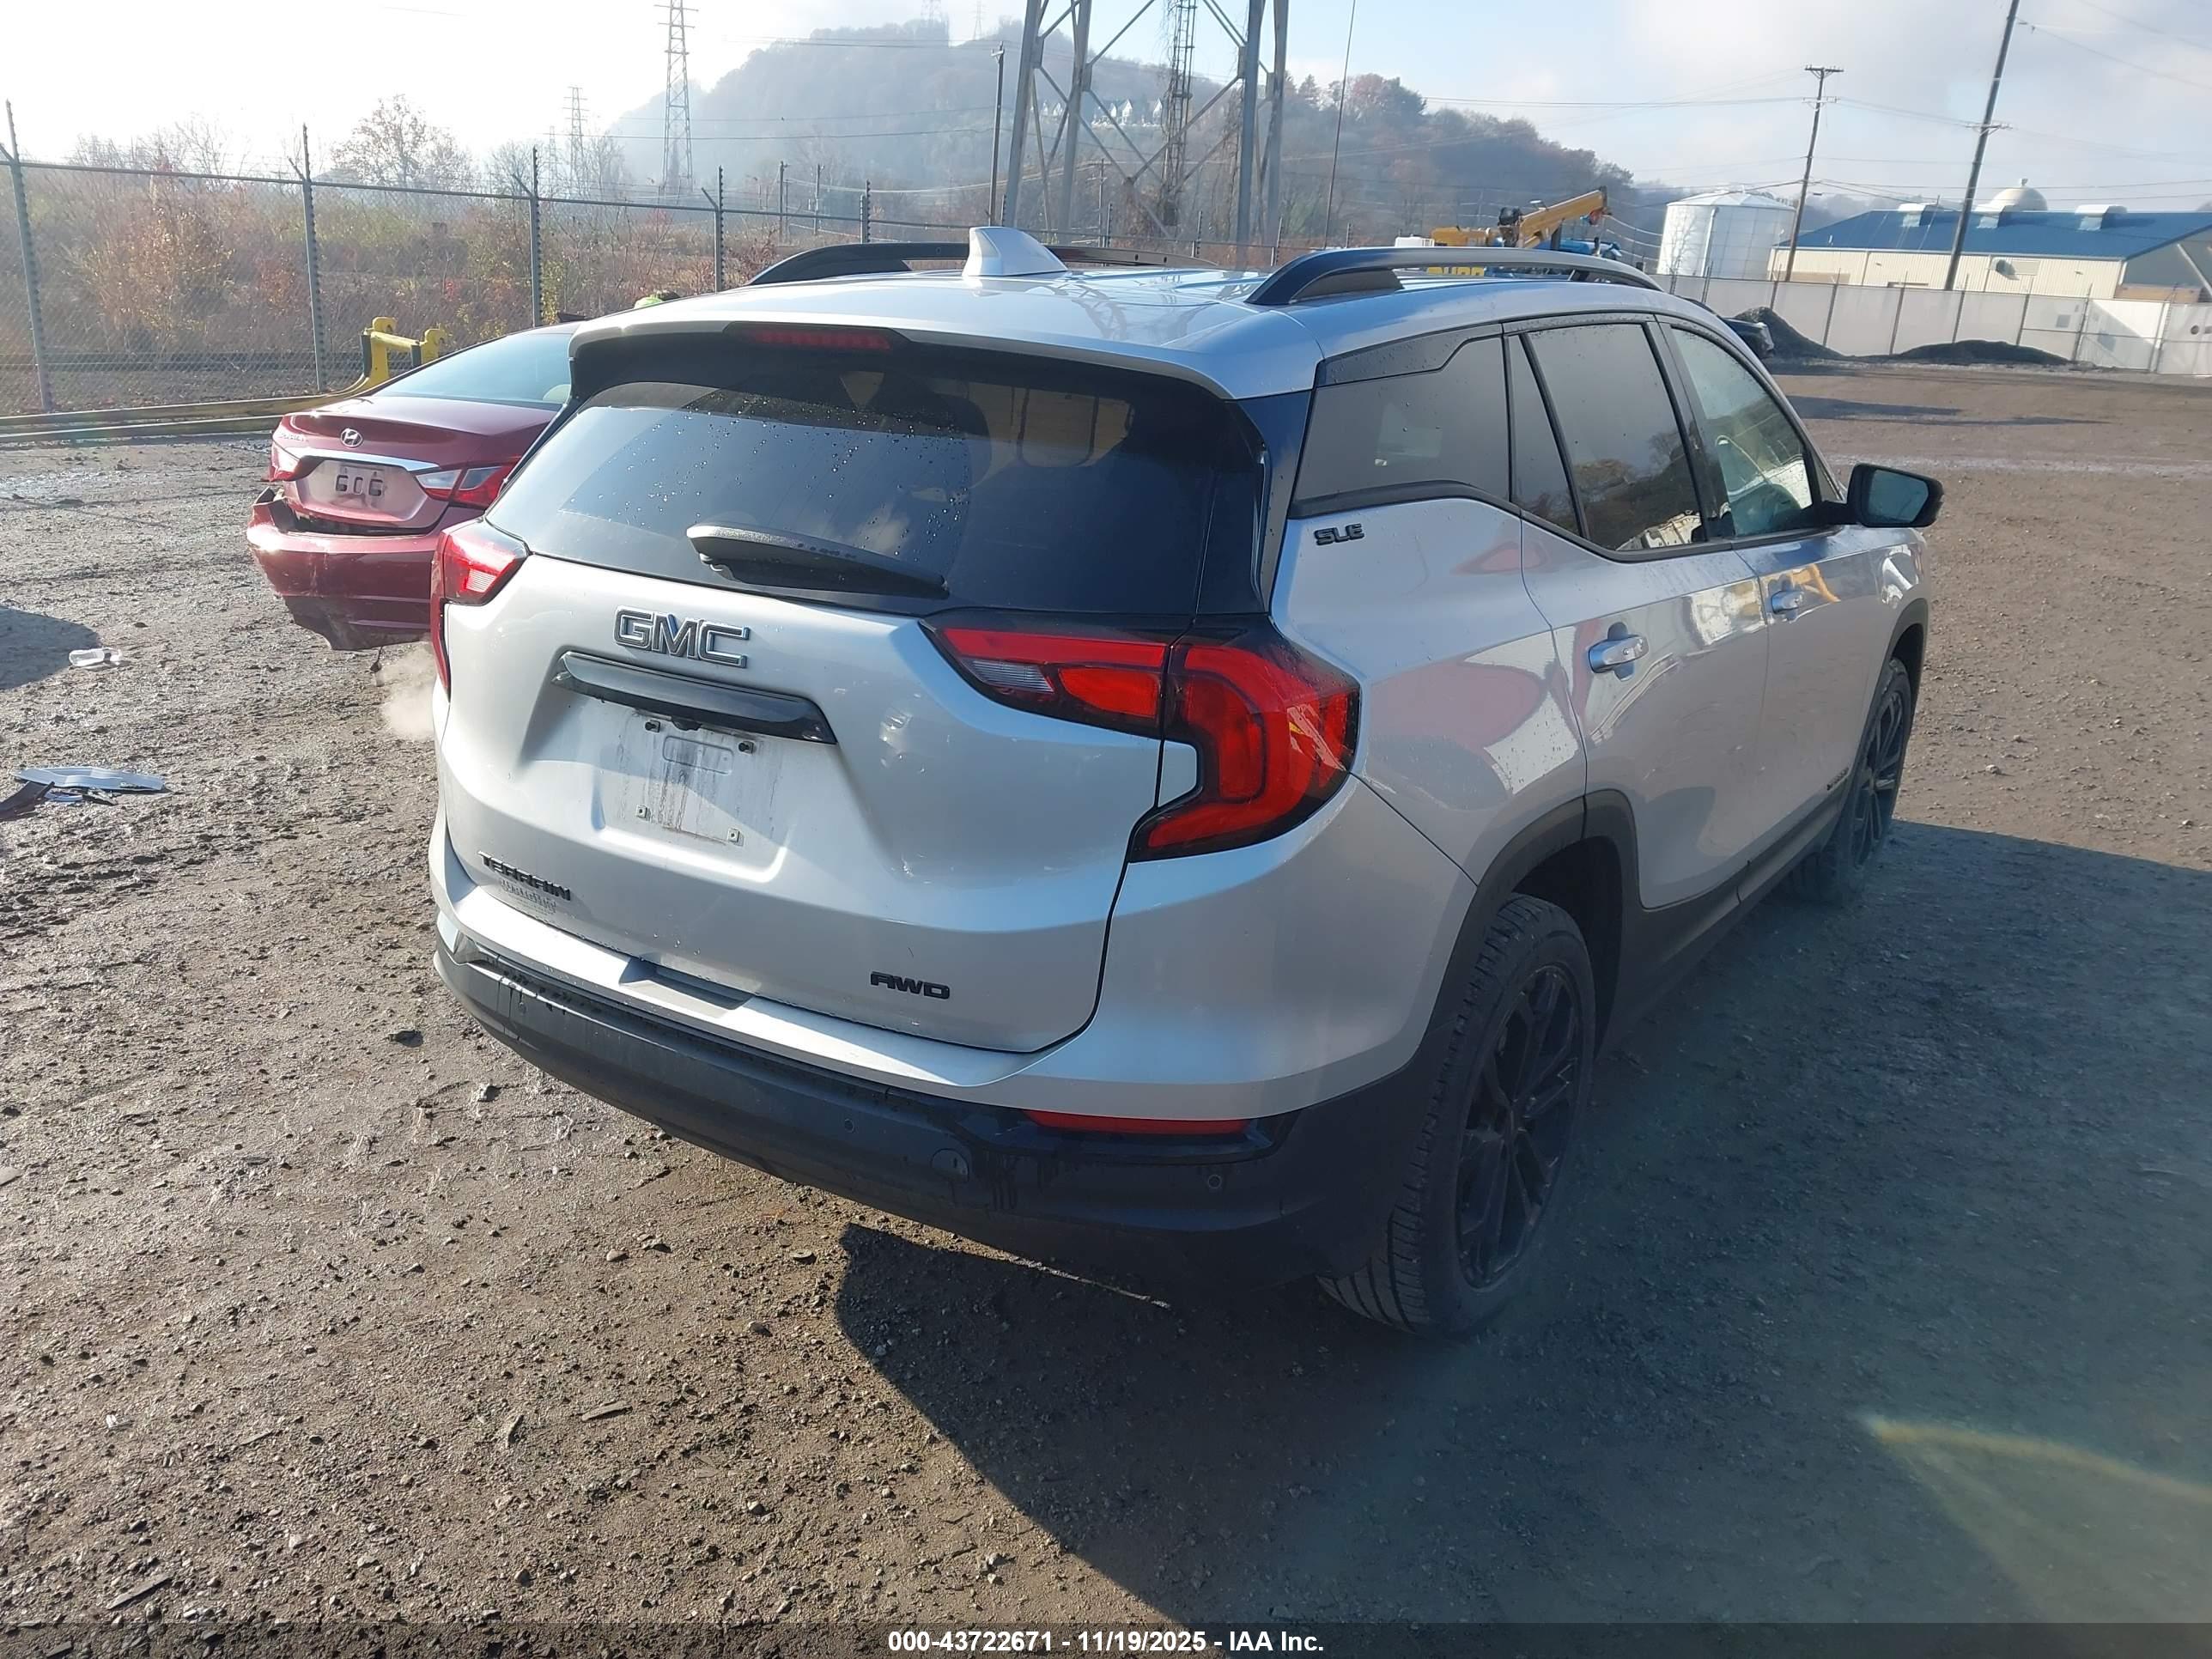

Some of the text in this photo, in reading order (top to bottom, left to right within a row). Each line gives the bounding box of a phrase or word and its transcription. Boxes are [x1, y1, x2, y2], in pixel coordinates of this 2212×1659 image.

[1314, 523, 1365, 546] SLE
[613, 605, 750, 669] GMC
[477, 850, 571, 902] TERRAIN
[870, 970, 951, 1000] AWD
